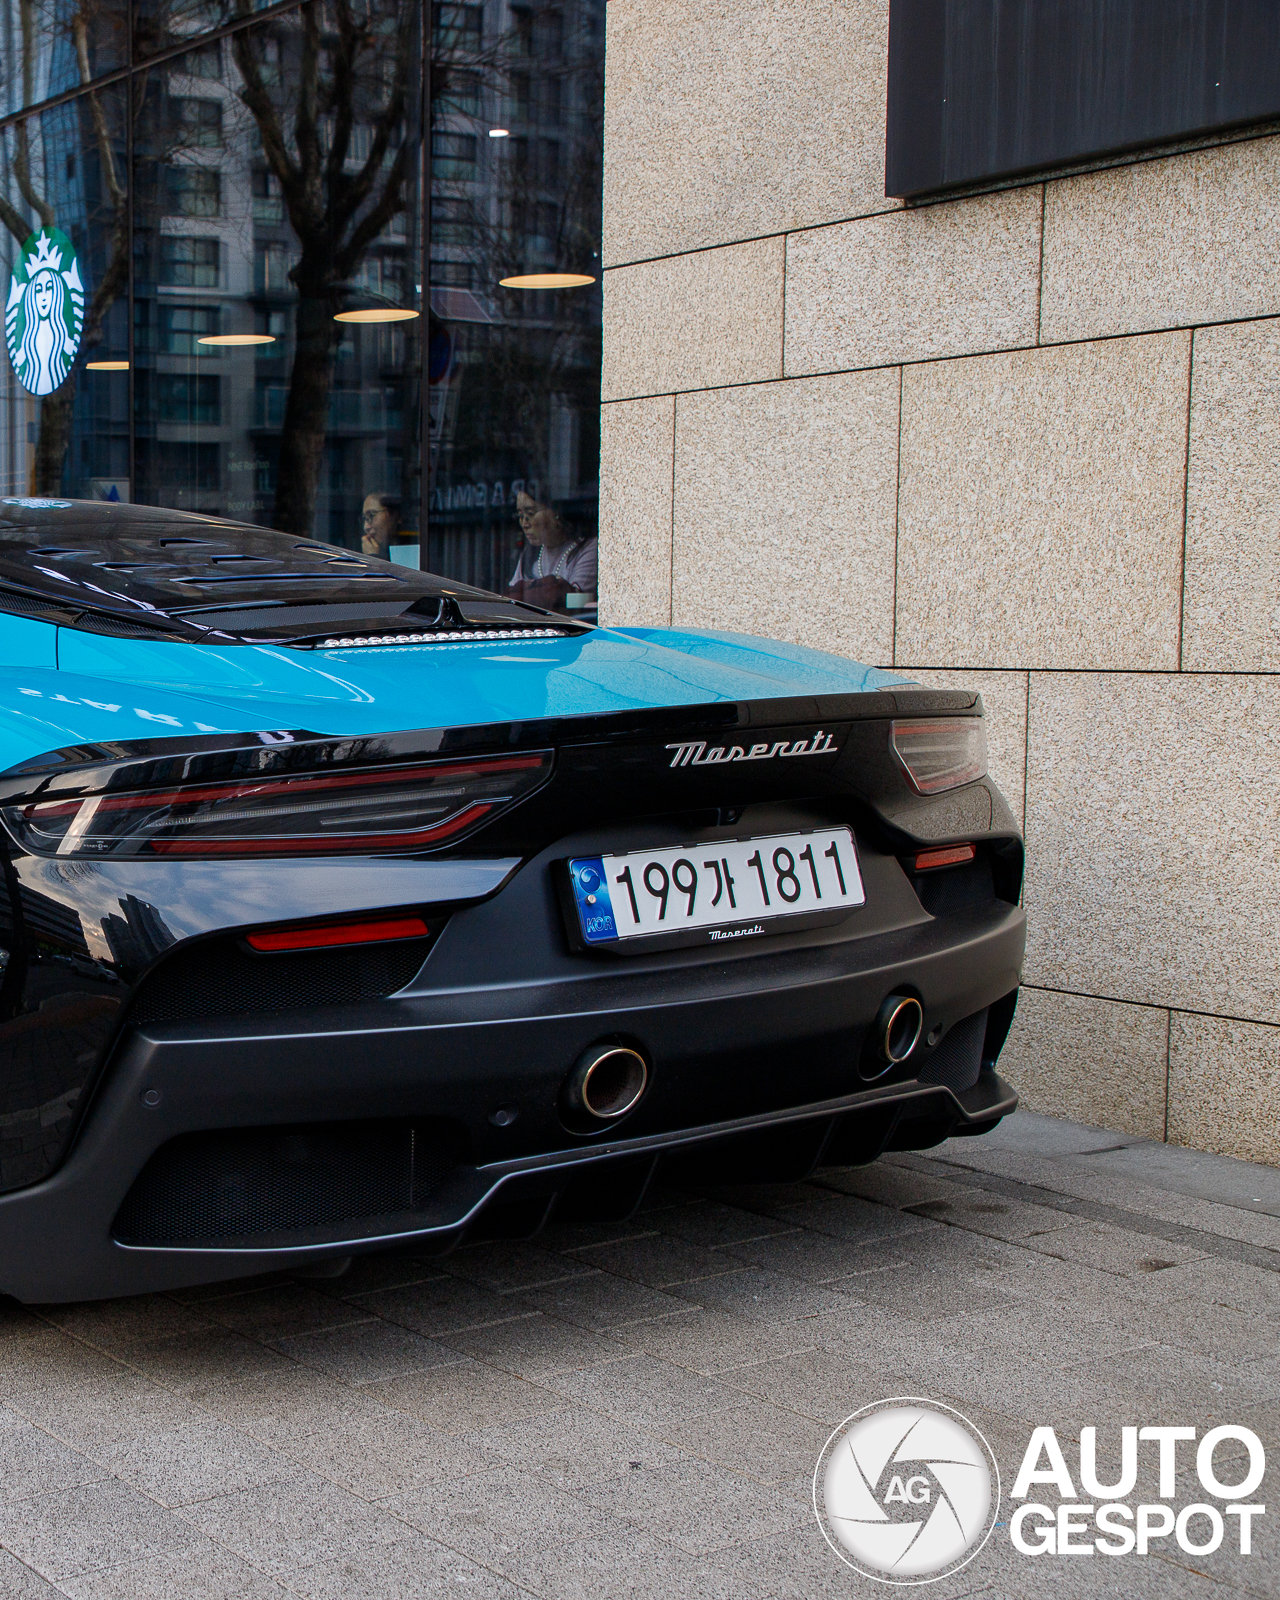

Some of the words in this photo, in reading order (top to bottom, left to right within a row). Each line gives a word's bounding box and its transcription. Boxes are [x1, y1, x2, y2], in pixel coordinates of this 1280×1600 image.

[665, 730, 838, 768] Maserati
[616, 858, 737, 923] 199가
[747, 840, 847, 906] 1811
[586, 916, 613, 933] KOR
[708, 924, 765, 941] Maserati
